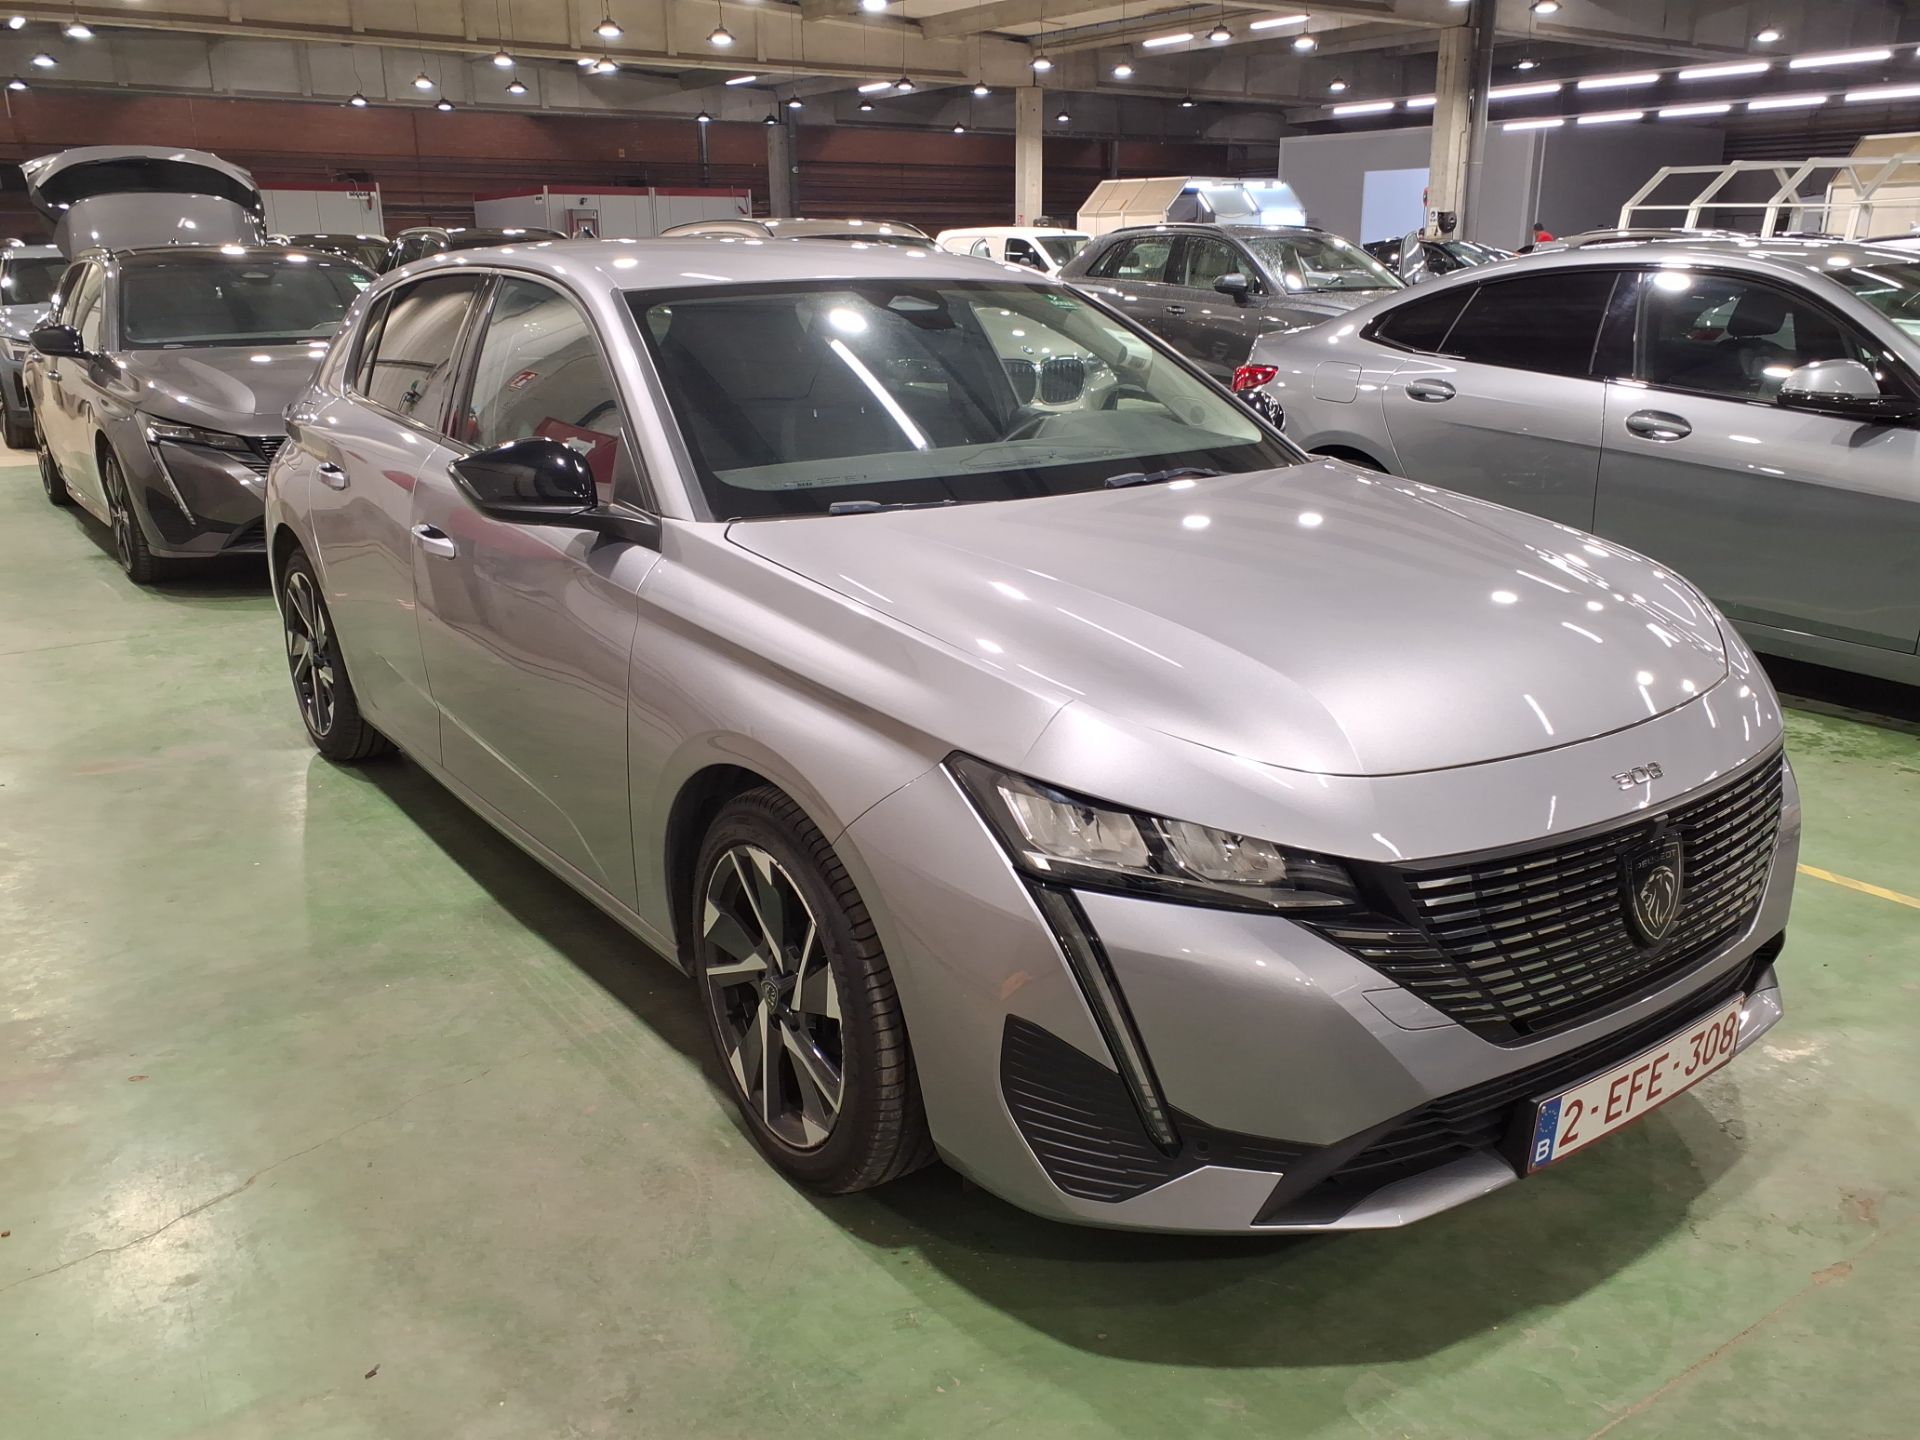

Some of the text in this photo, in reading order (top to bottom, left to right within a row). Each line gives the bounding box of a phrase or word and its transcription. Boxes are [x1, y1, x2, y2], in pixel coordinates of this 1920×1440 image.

[1611, 761, 1664, 790] 308
[1535, 1011, 1738, 1162] B 2-EFE-308
